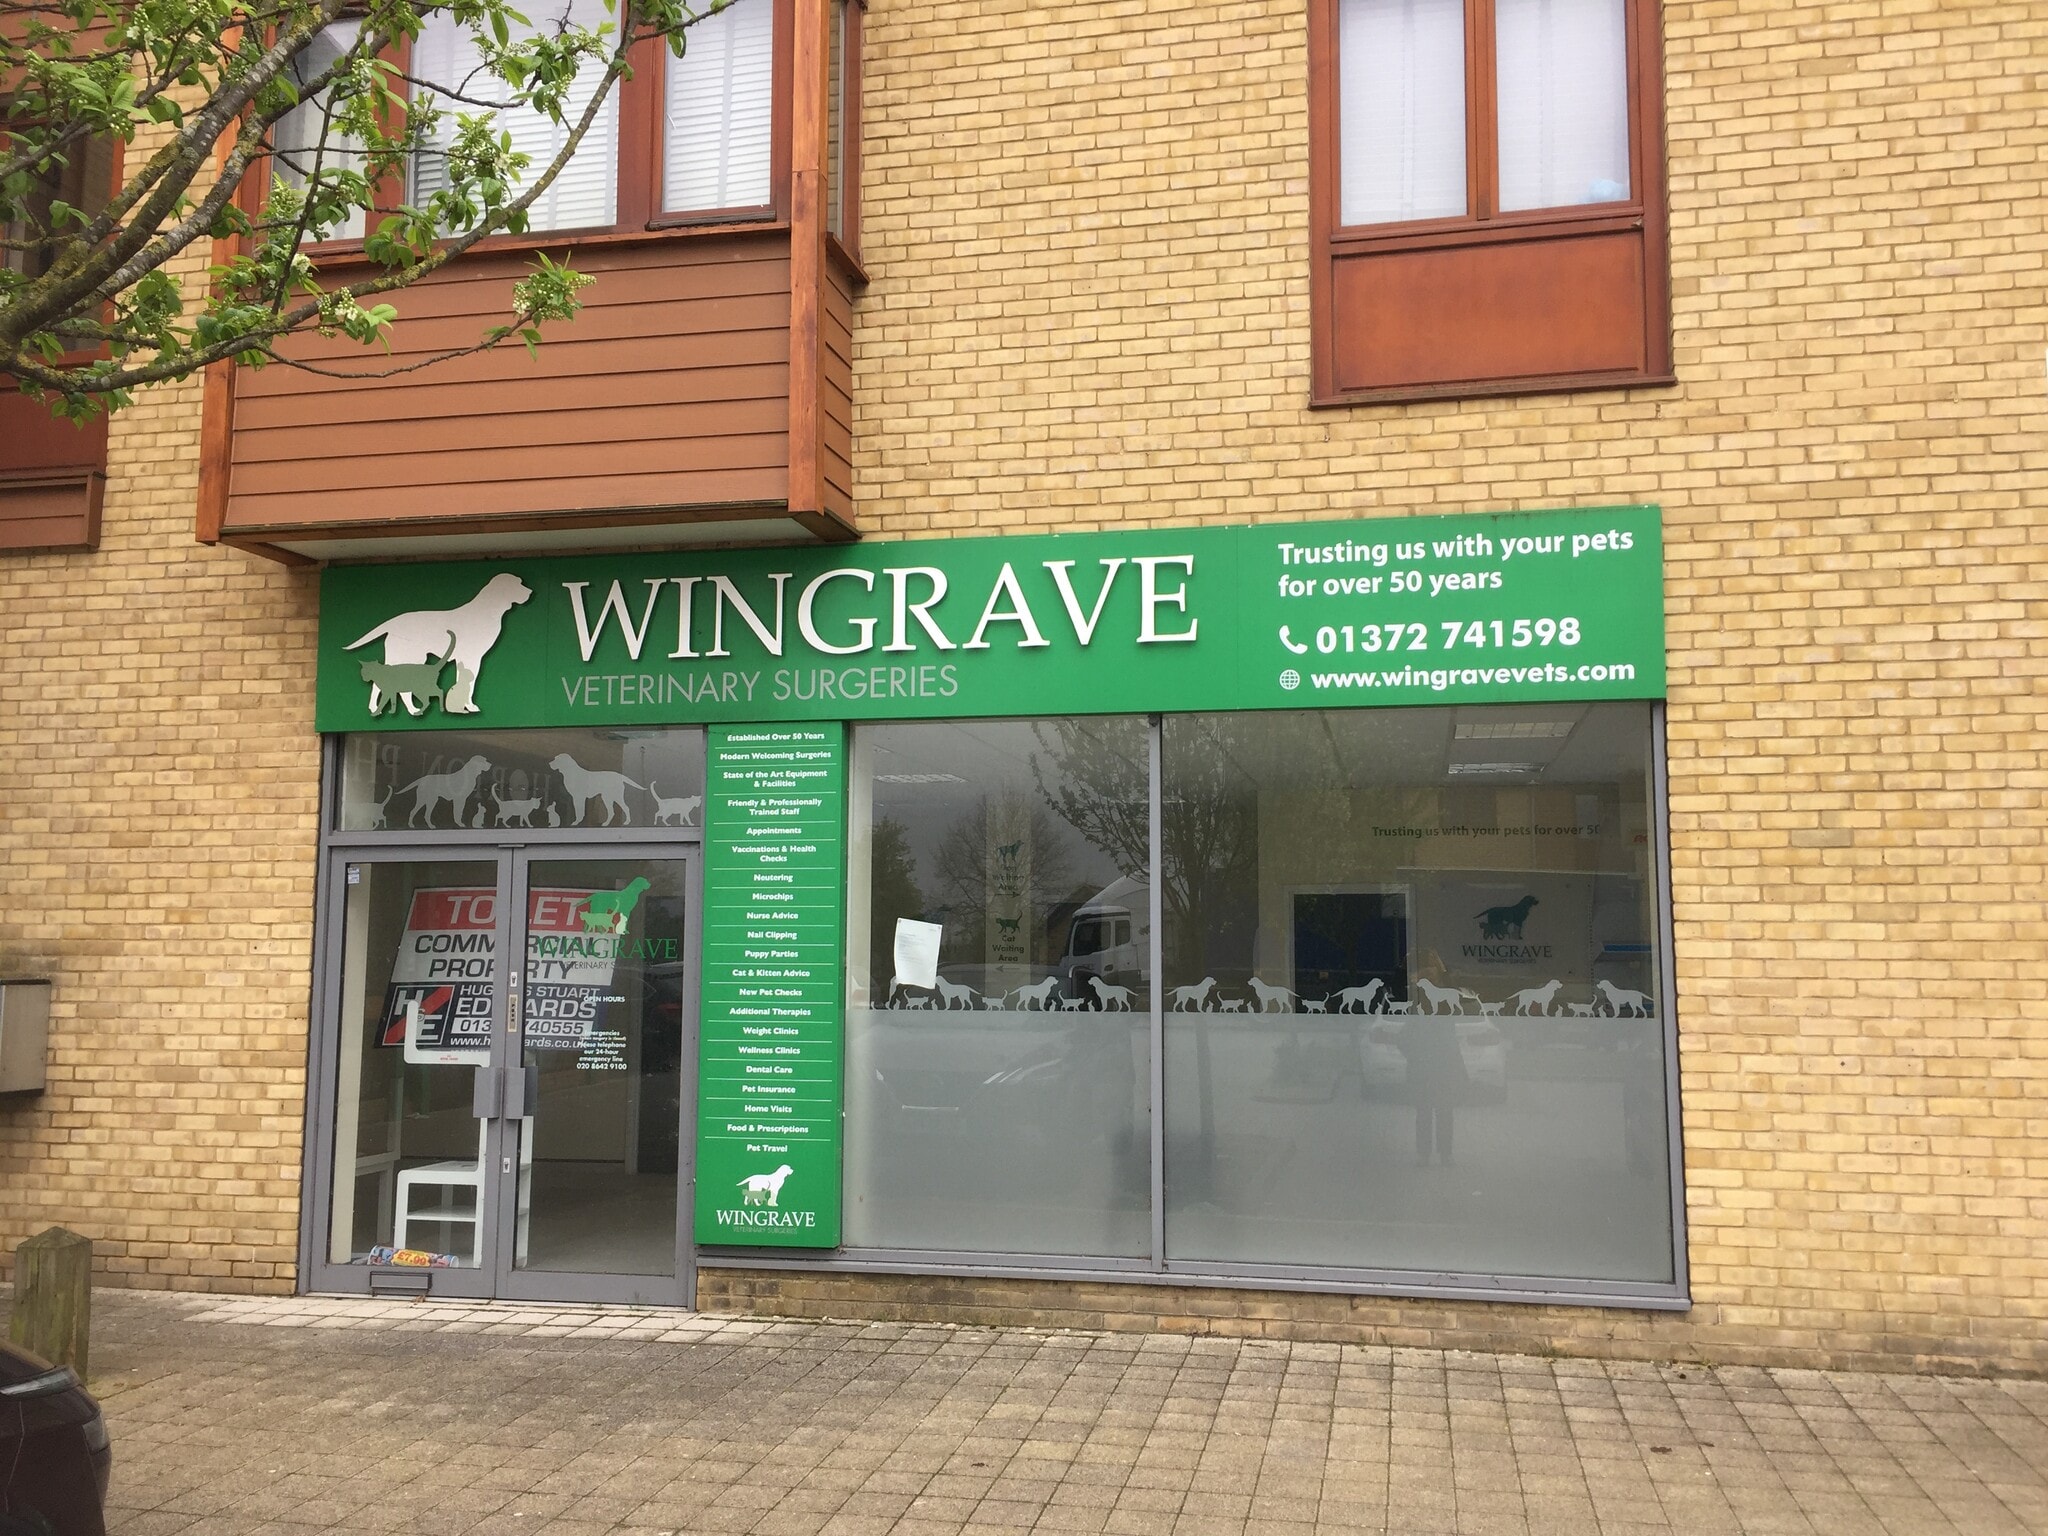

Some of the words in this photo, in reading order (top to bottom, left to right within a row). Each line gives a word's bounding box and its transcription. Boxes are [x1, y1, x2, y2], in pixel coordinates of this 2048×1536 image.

[1278, 540, 1389, 568] Trusting
[1395, 540, 1425, 559] us
[1432, 534, 1493, 559] with
[1501, 534, 1564, 562] your
[1571, 529, 1633, 557] pets
[1279, 574, 1316, 597] for
[1323, 575, 1382, 596] over
[1389, 571, 1422, 593] 50
[1429, 570, 1502, 596] years
[562, 553, 1199, 662] WINGRAVE
[1316, 624, 1428, 655] 01372
[1441, 616, 1580, 652] 741598
[1311, 661, 1635, 690] www.wingravevets.com
[561, 671, 761, 708] VETERINARY
[772, 665, 958, 699] SURGERIES
[752, 752, 794, 760] Welcoming
[796, 751, 831, 759] Surgeries
[769, 799, 822, 809] Professionally
[747, 827, 801, 836] Appointments
[1372, 826, 1422, 838] Trusting
[1426, 828, 1439, 836] us
[1442, 826, 1469, 836] with
[1472, 828, 1500, 838] your
[1504, 827, 1530, 838] pets
[1534, 825, 1552, 836] for
[1555, 826, 1583, 835] over
[754, 874, 793, 882] Neutering
[752, 893, 793, 901] Microchips
[447, 895, 496, 924] TO
[765, 932, 797, 940] Clipping
[537, 938, 678, 959] WINGRAVE
[745, 950, 769, 959] Puppy
[1462, 945, 1552, 957] WINGRAVE
[536, 986, 600, 999] STUART
[772, 1008, 811, 1017] Therapies
[743, 1027, 771, 1036] Weight
[771, 1105, 792, 1113] Visits
[757, 1125, 808, 1134] Prescriptions
[717, 1210, 815, 1226] WINGRAVE
[397, 1252, 427, 1265] £7.99
